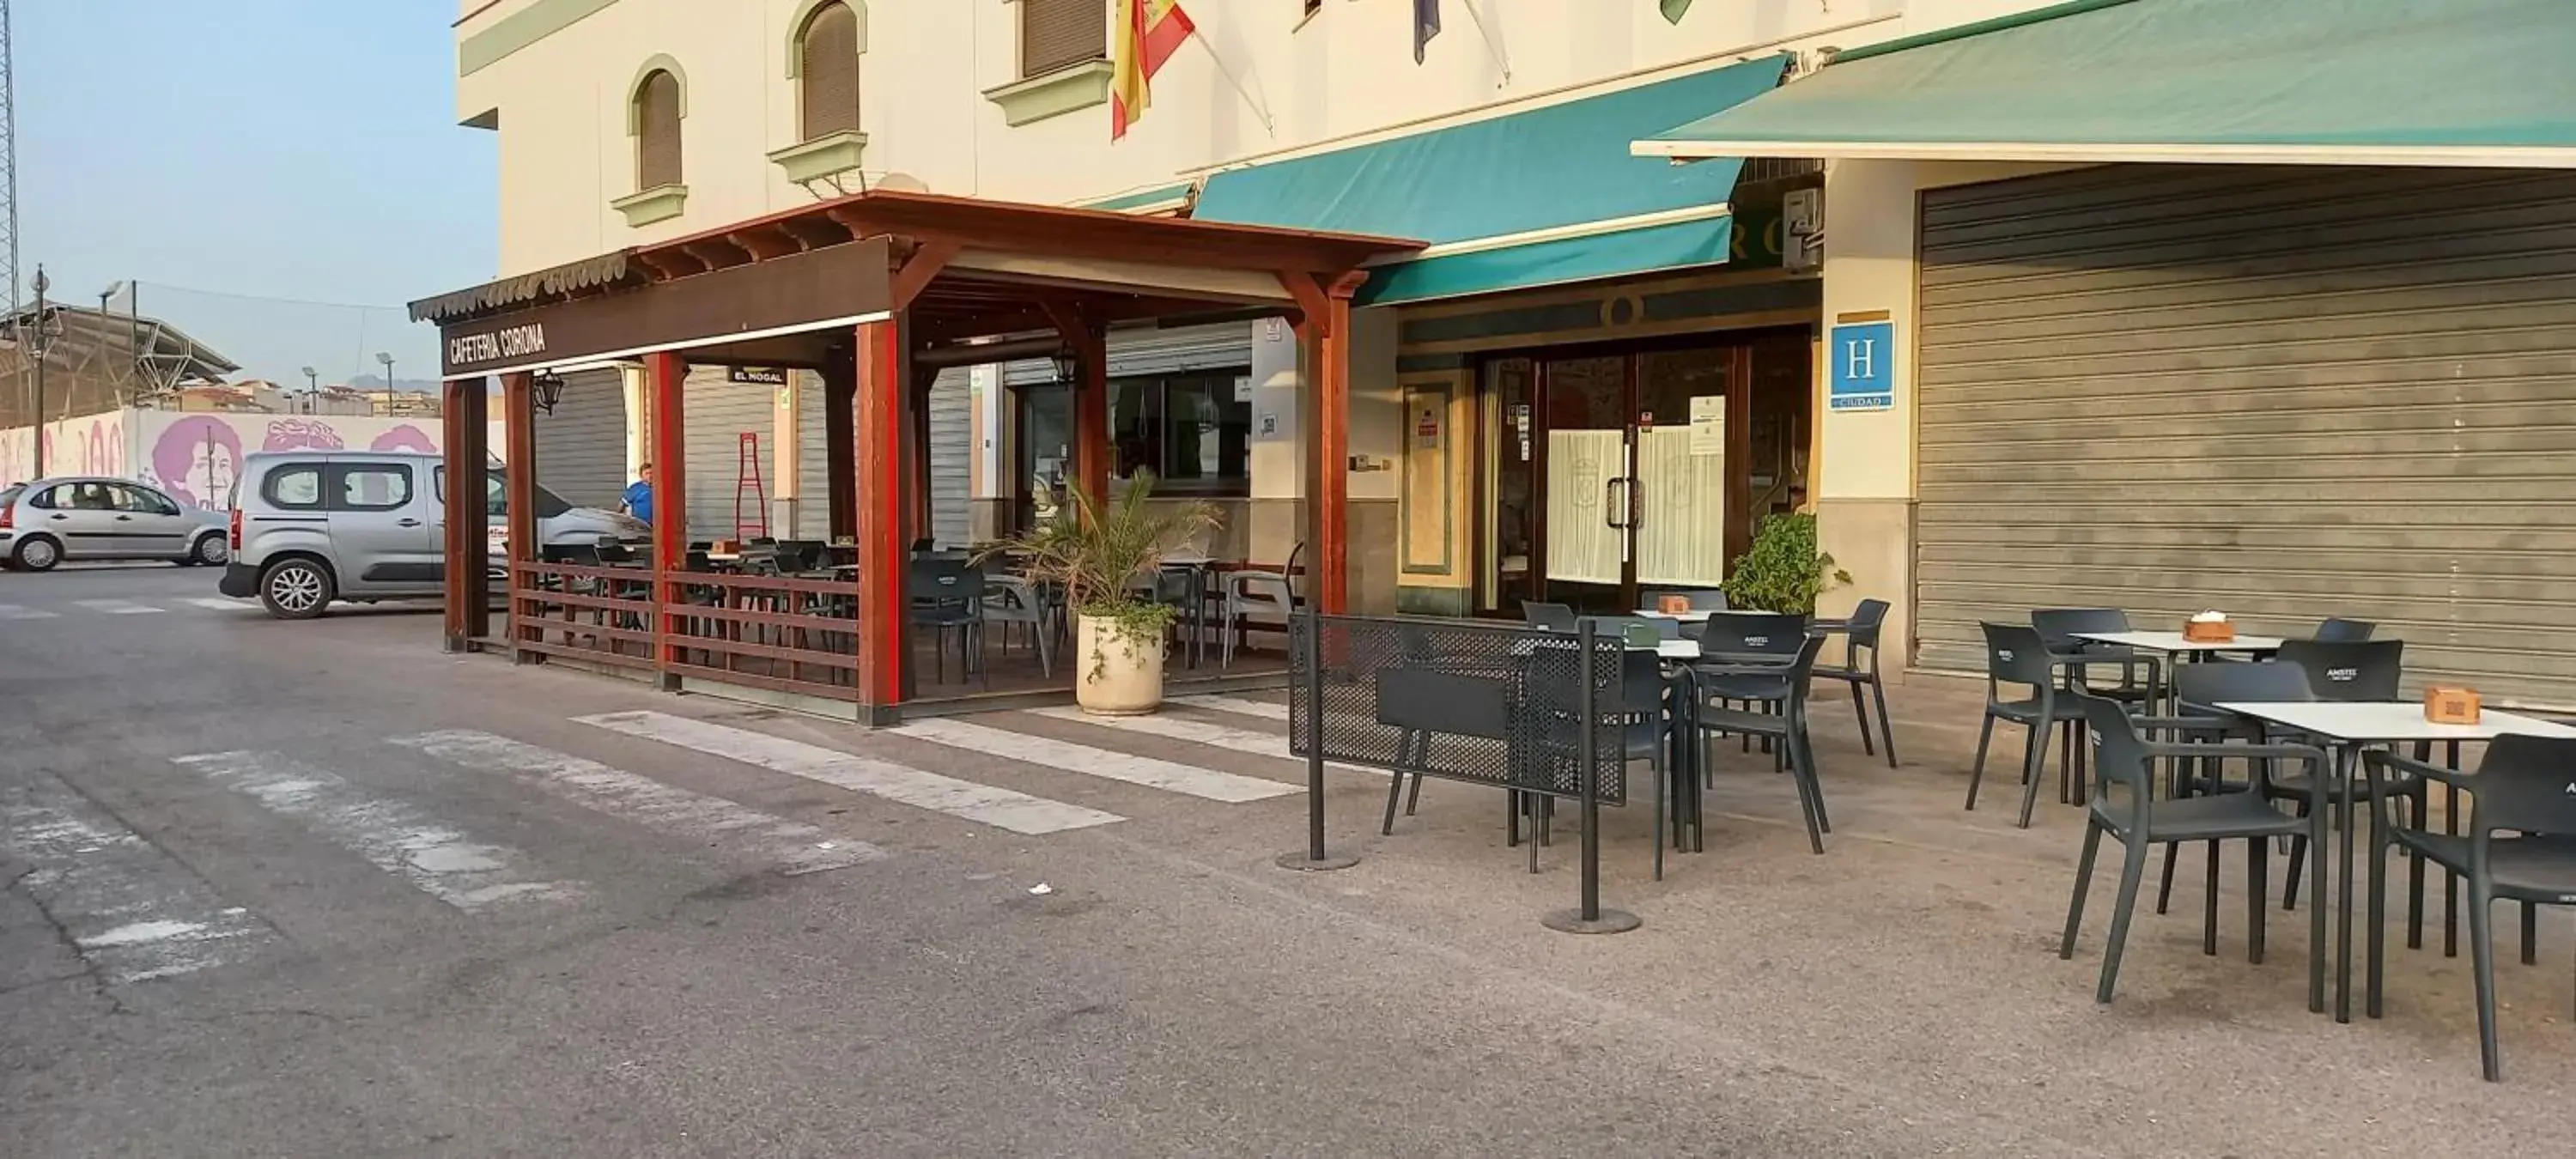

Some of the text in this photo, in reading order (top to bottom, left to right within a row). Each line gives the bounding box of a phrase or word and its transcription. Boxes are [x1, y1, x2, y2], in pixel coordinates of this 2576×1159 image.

[450, 323, 545, 364] CAFETERIA CORONA
[1844, 338, 1875, 379] H
[734, 371, 782, 382] EL NOGAL
[1839, 397, 1882, 407] CIUDAD
